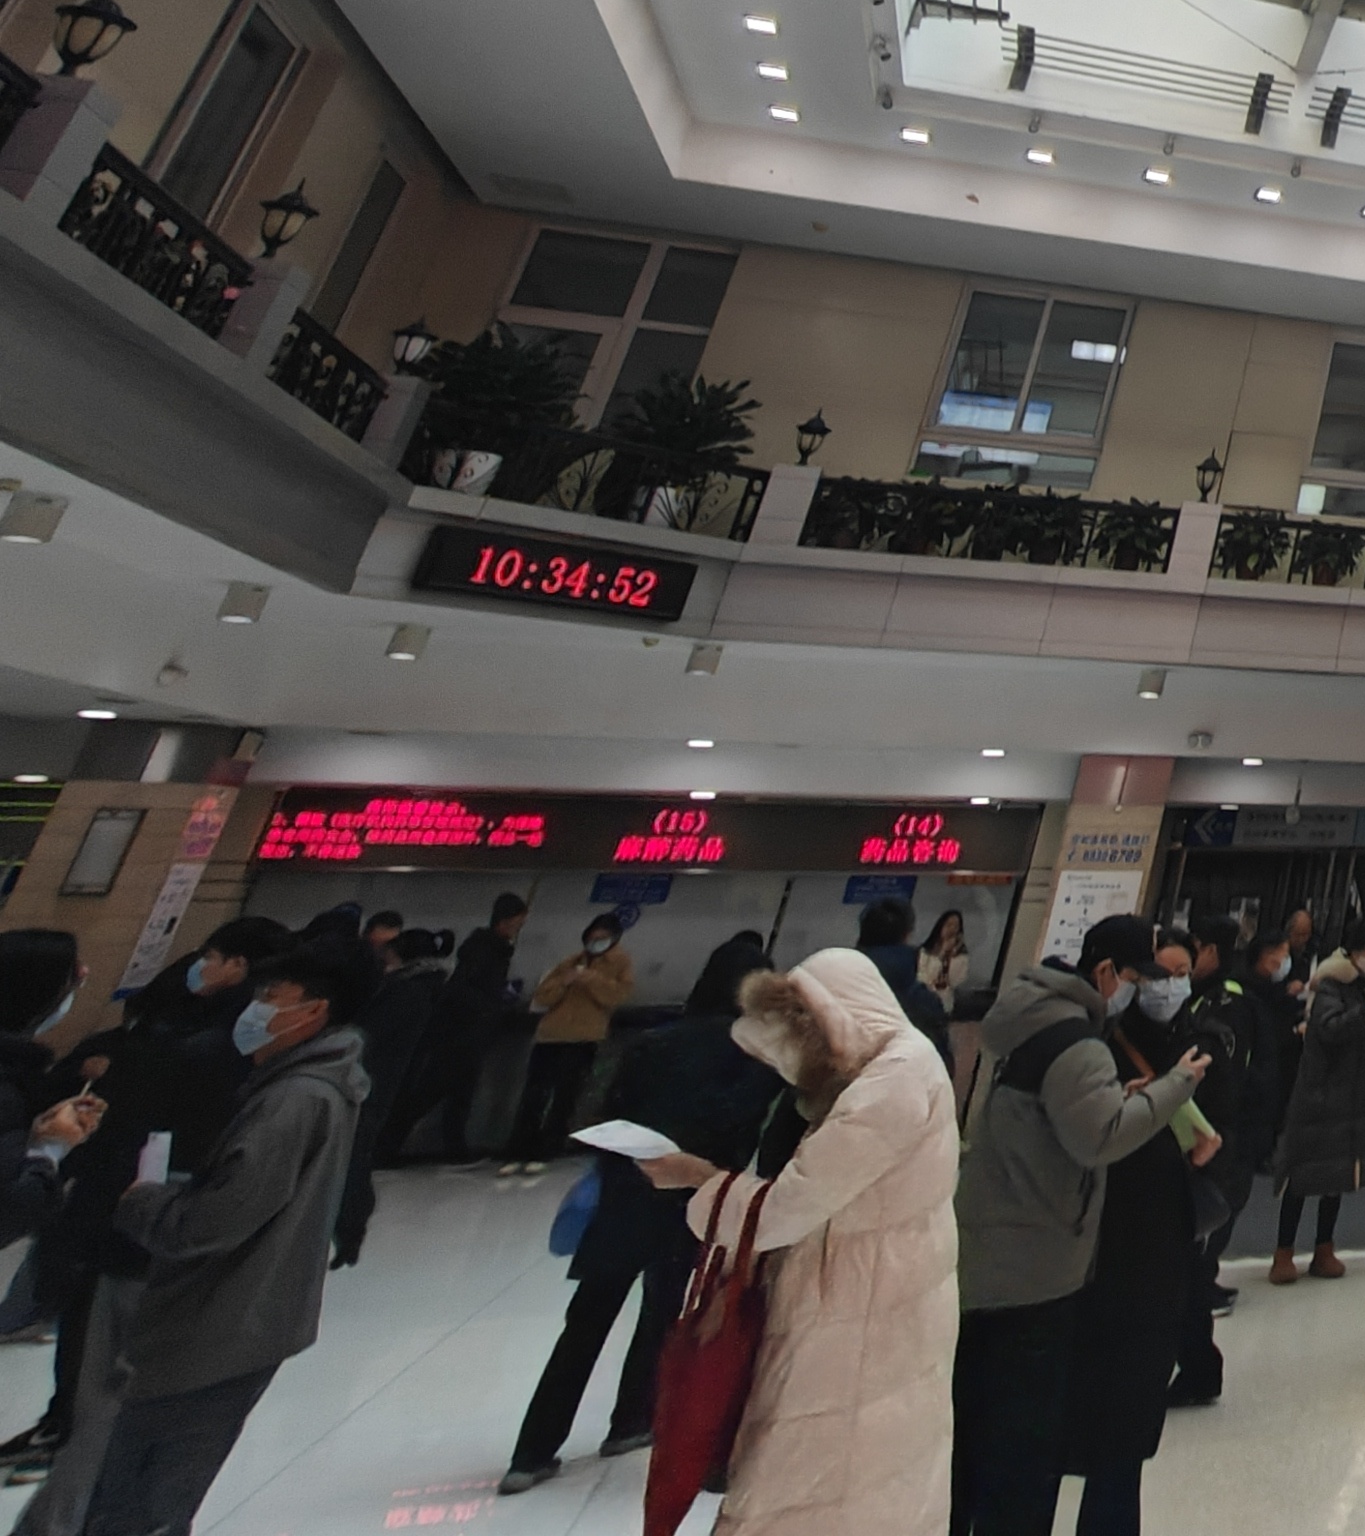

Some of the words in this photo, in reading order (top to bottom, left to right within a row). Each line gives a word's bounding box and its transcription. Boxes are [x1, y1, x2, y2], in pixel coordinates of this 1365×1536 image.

[470, 545, 659, 608] 10:34:52
[893, 813, 944, 837] (14)
[859, 837, 961, 864] 药品咨询
